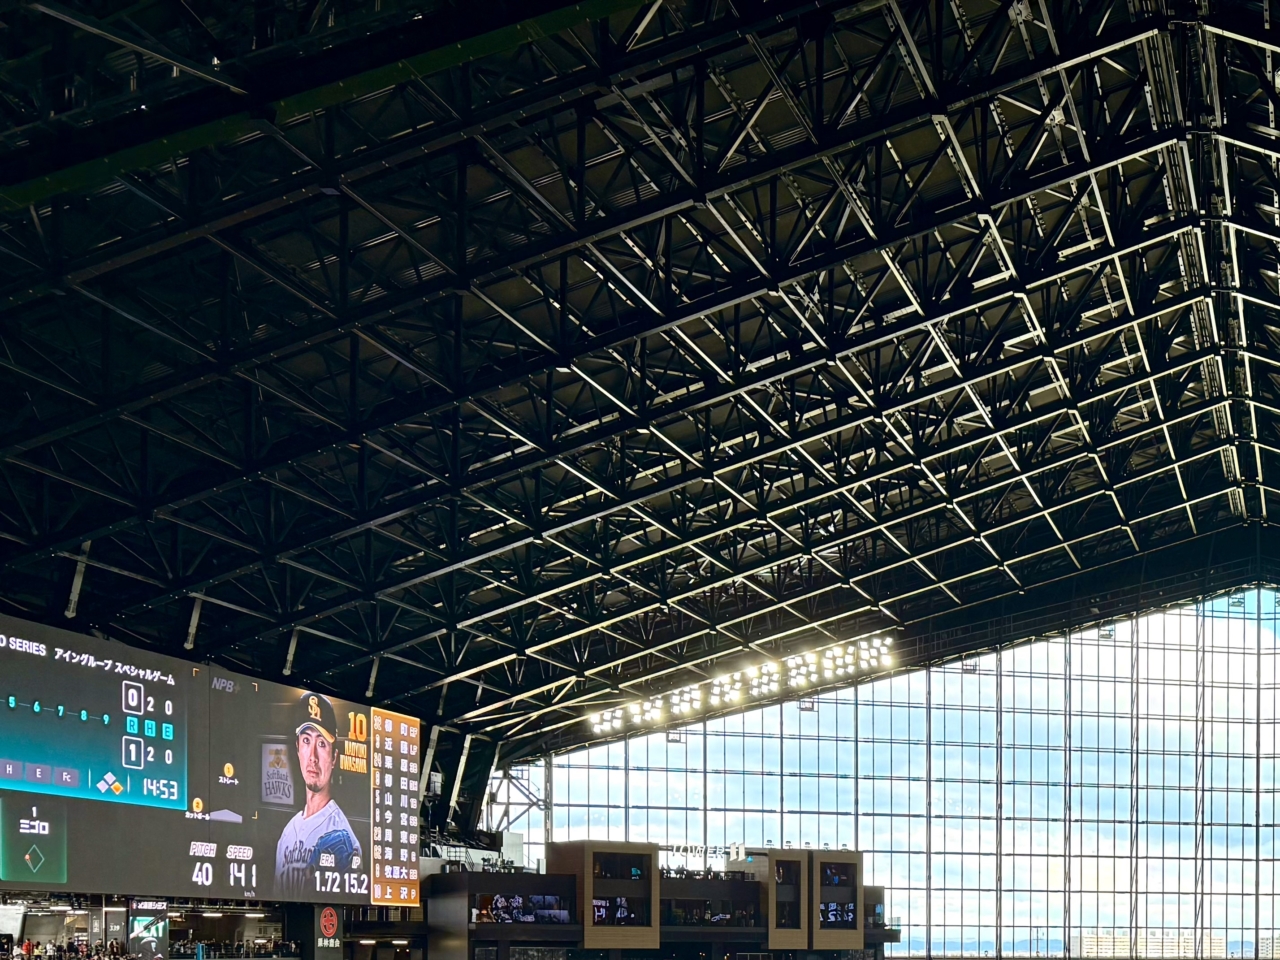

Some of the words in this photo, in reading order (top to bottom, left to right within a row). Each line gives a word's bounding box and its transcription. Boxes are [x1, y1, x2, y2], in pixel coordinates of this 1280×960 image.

[9, 637, 46, 656] SERIES
[115, 662, 175, 685] スペシャルゲーム
[9, 696, 16, 708] 5
[33, 701, 41, 712] 6
[58, 706, 64, 717] 7
[81, 710, 87, 721] 8
[103, 714, 109, 724] 9
[128, 688, 138, 707] 0
[147, 696, 154, 712] 2
[165, 700, 173, 715] 0
[348, 711, 367, 742] 10
[129, 743, 136, 762] 1
[147, 746, 154, 762] 2
[165, 749, 173, 765] 0
[143, 777, 178, 800] 14:53
[264, 781, 292, 798] HAWKS
[190, 842, 217, 857] PITCH
[226, 845, 253, 860] SPEED
[320, 854, 335, 867] ERA
[352, 856, 360, 869] IP
[671, 844, 726, 860] TOWER
[192, 862, 213, 886] 40
[315, 870, 340, 893] 1.72
[344, 873, 369, 894] 15.2
